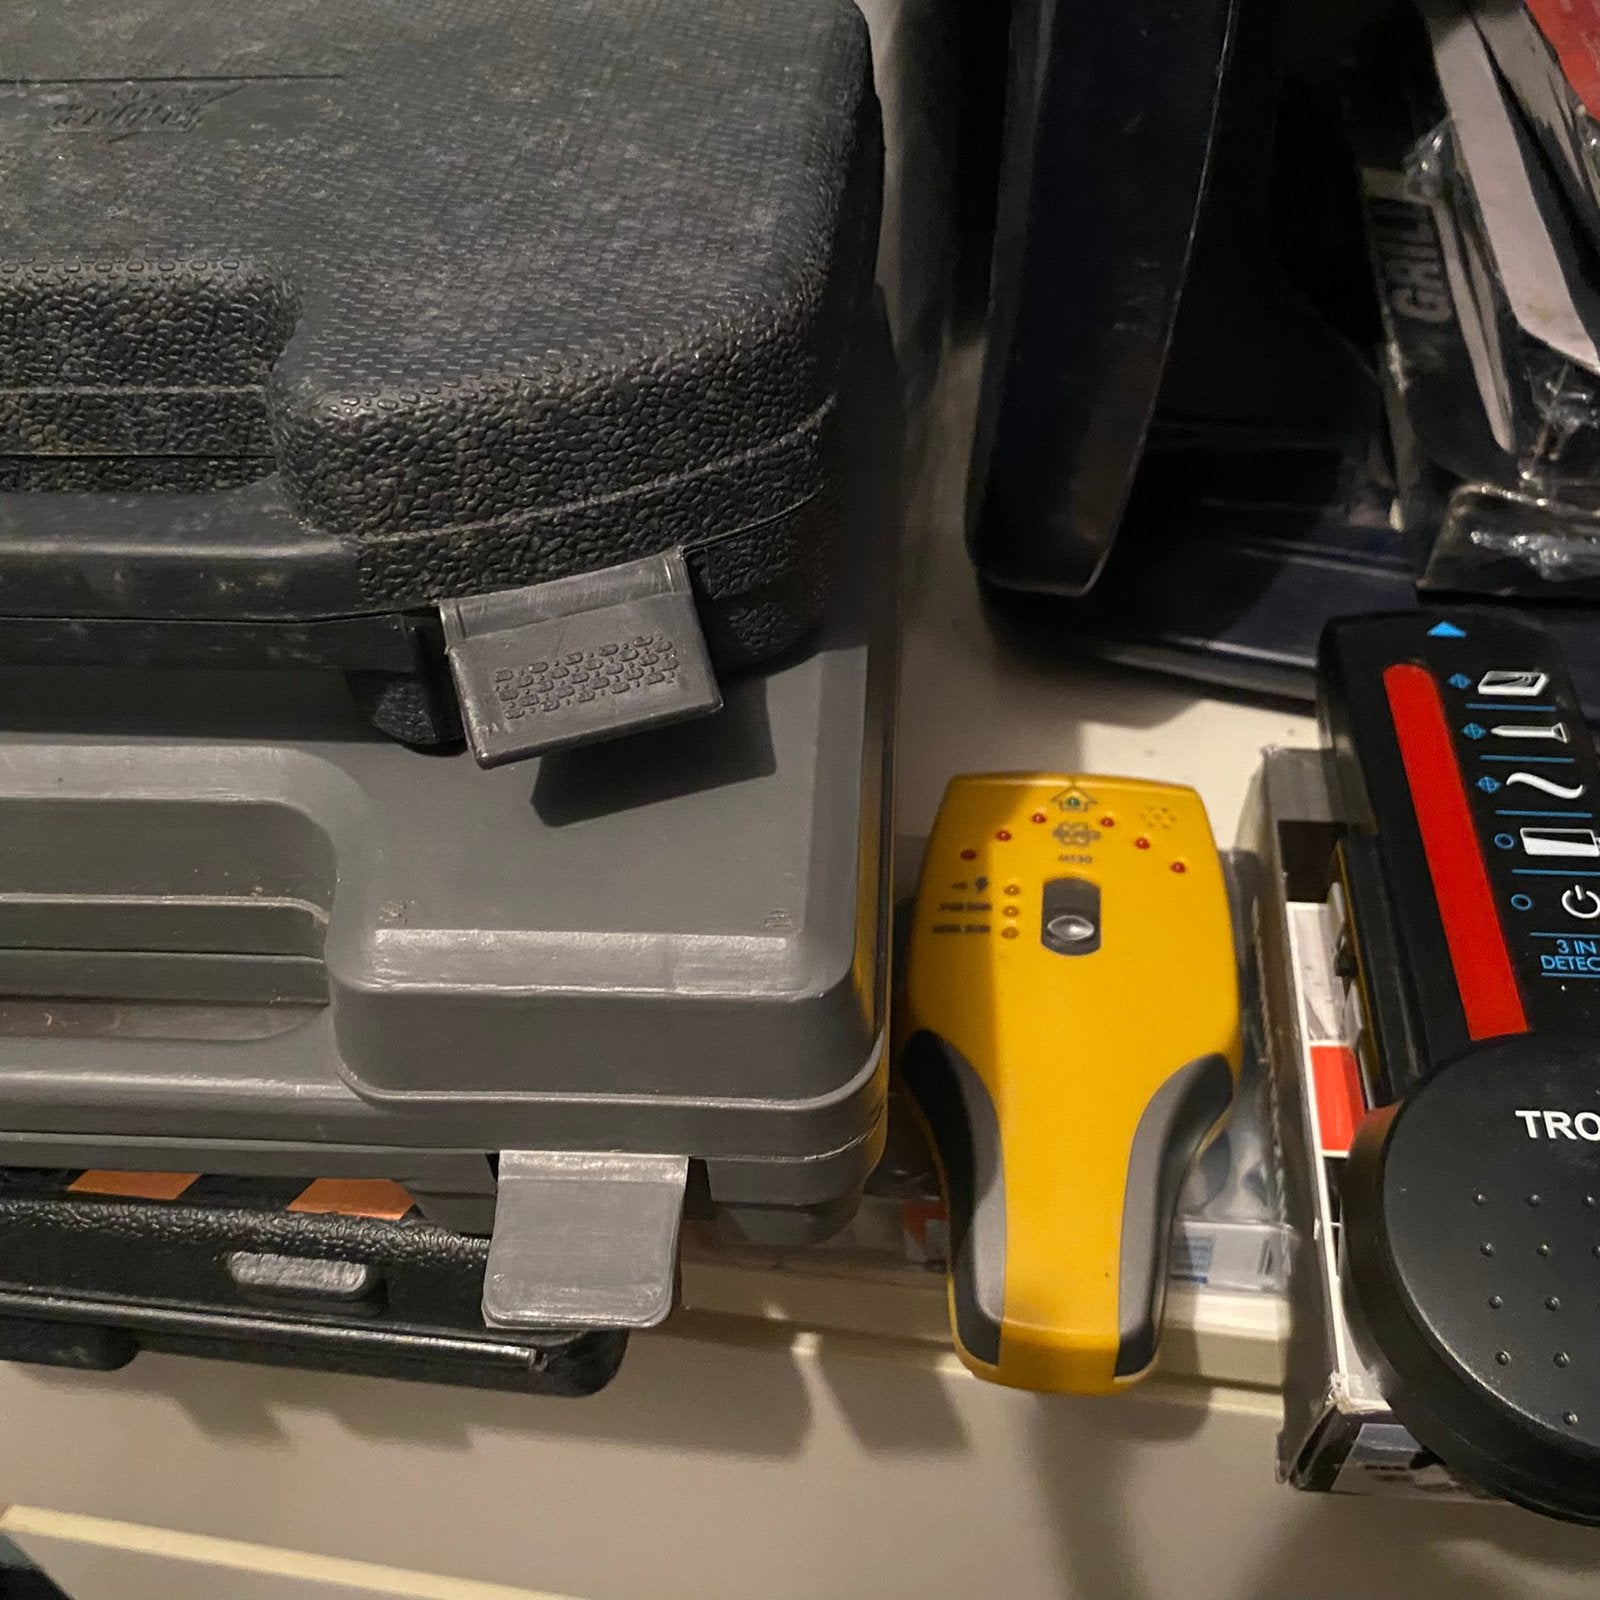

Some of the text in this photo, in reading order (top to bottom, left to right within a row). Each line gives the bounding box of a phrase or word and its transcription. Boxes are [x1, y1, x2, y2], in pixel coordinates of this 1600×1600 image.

[1556, 939, 1597, 955] 3 IN
[1540, 955, 1600, 972] DETEC
[1515, 1110, 1600, 1141] TRO
